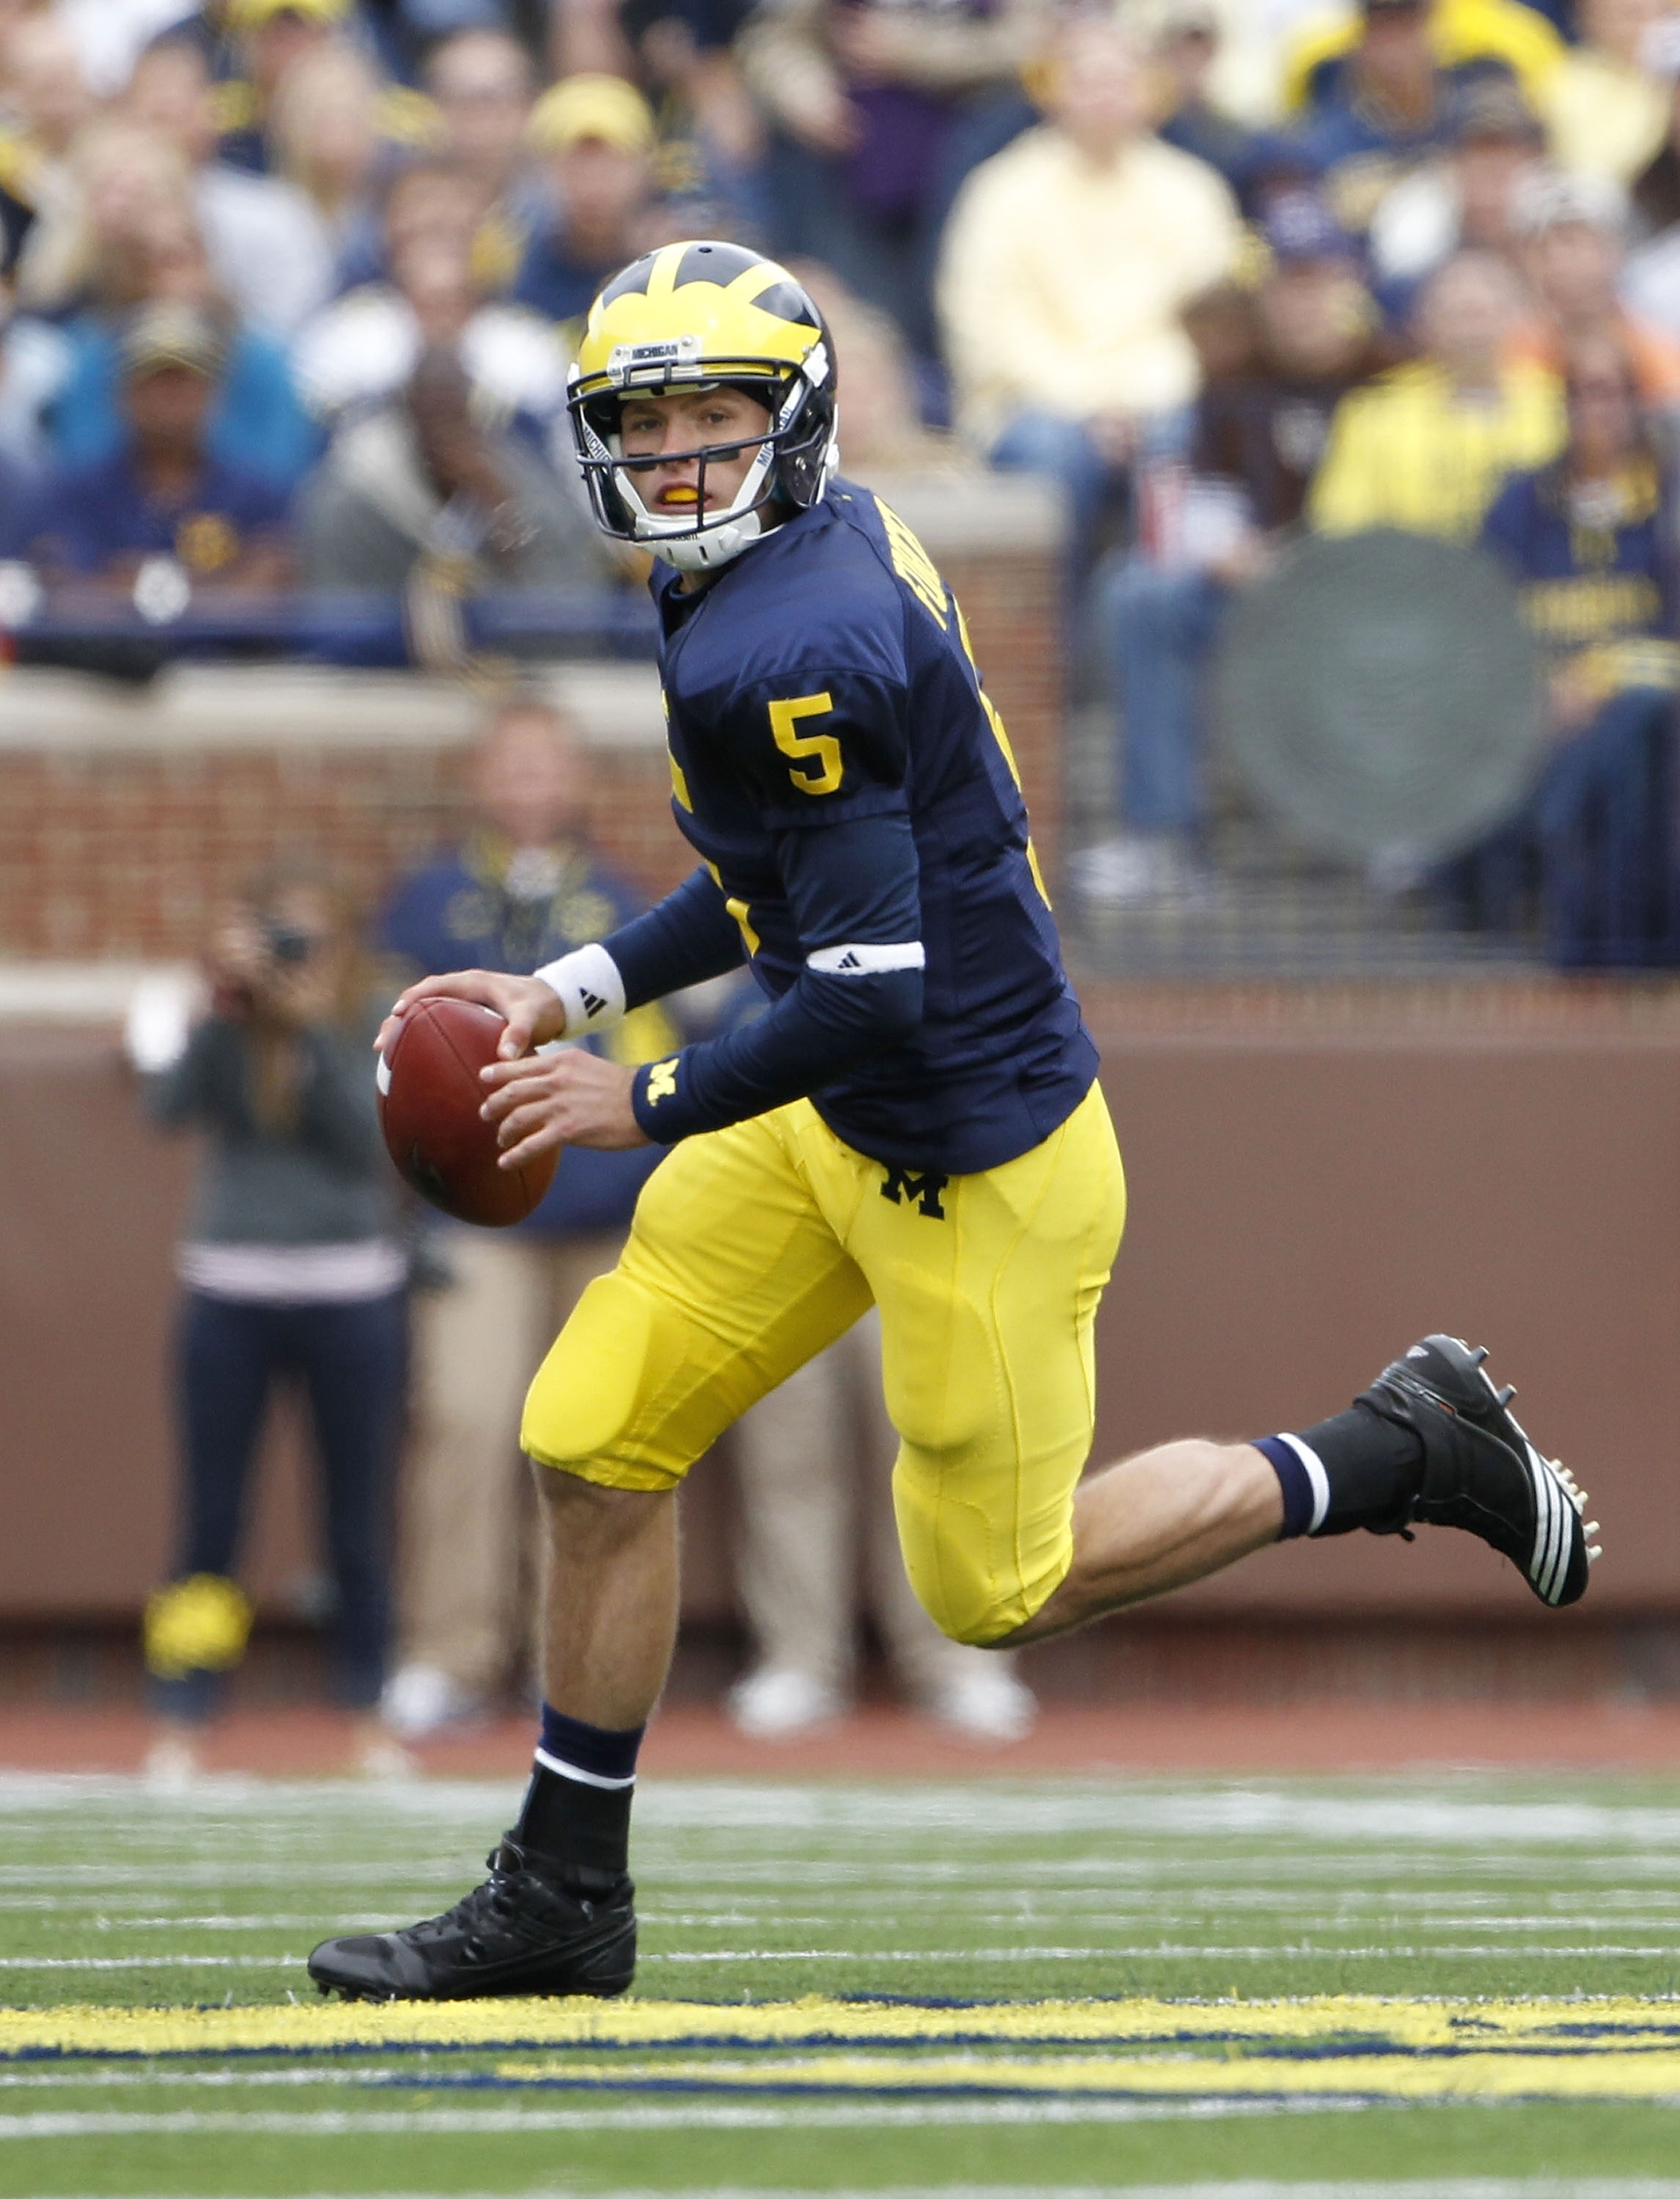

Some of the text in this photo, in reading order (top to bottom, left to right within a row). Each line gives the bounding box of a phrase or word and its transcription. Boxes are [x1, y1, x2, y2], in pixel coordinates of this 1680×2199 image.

[632, 343, 678, 359] MICHIGAN
[768, 690, 844, 795] 5
[647, 1058, 679, 1101] M
[880, 1163, 950, 1221] M
